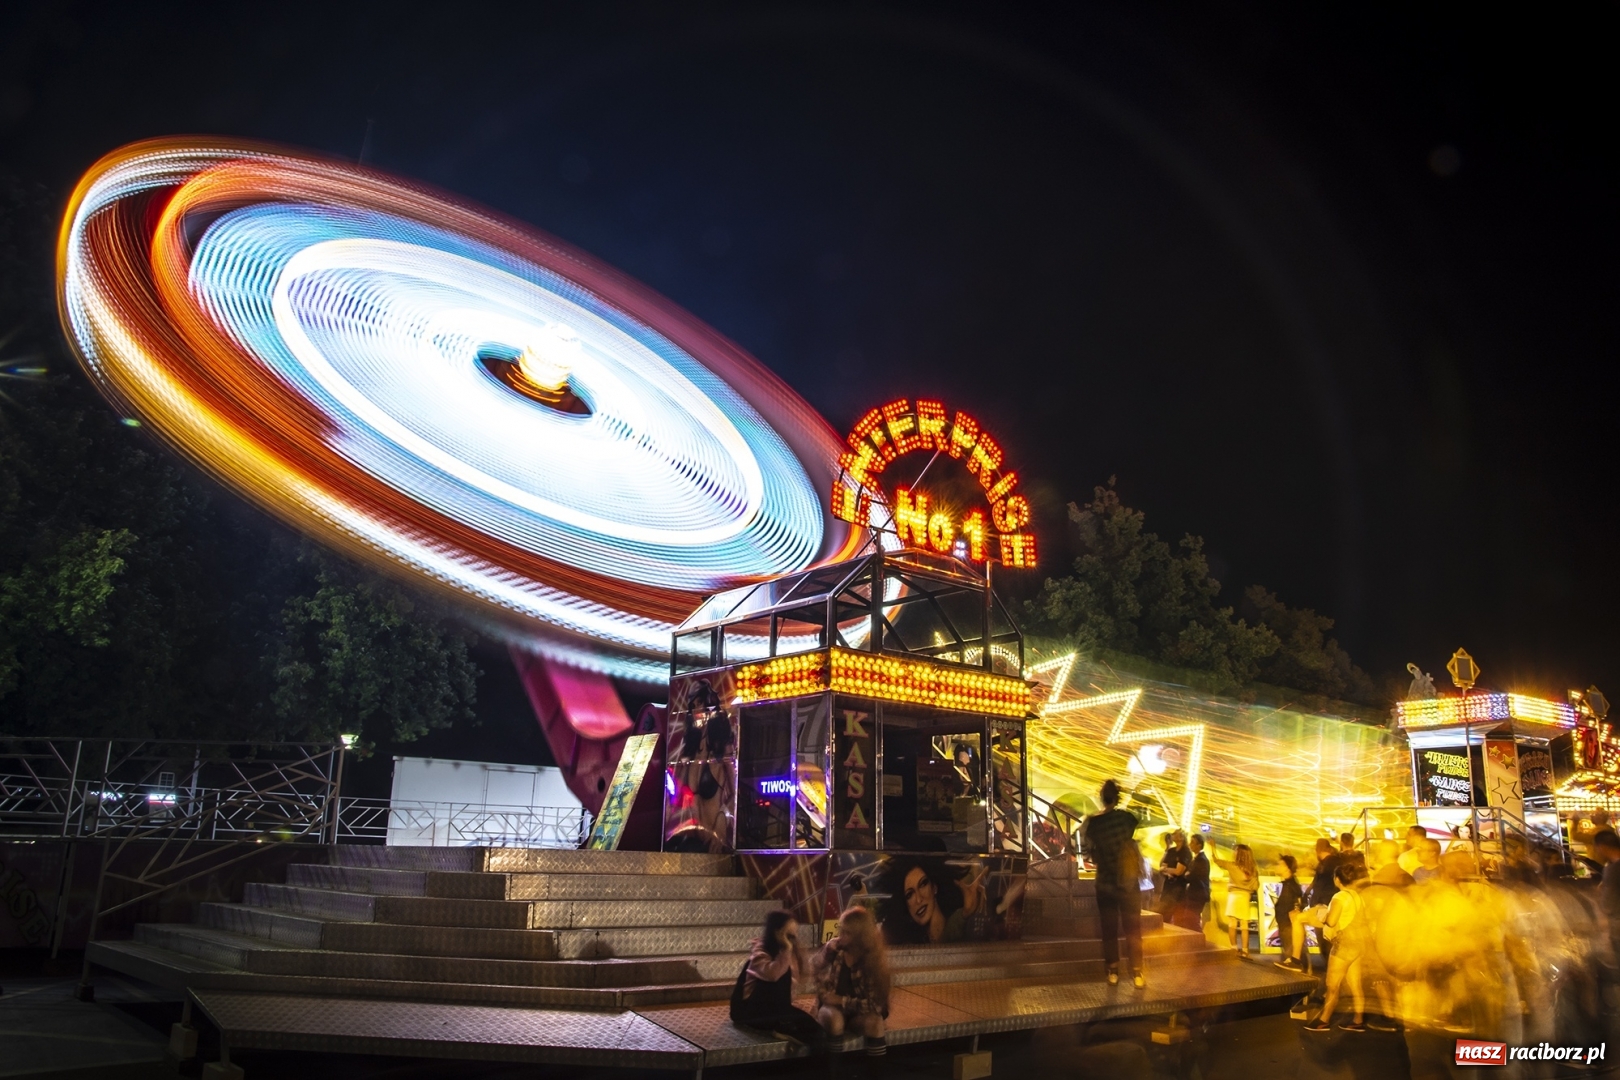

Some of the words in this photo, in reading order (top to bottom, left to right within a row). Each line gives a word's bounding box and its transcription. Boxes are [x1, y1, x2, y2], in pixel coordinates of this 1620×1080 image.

[830, 399, 1037, 568] ENTERPRISE
[843, 709, 869, 829] KASA
[997, 729, 1019, 839] KASA
